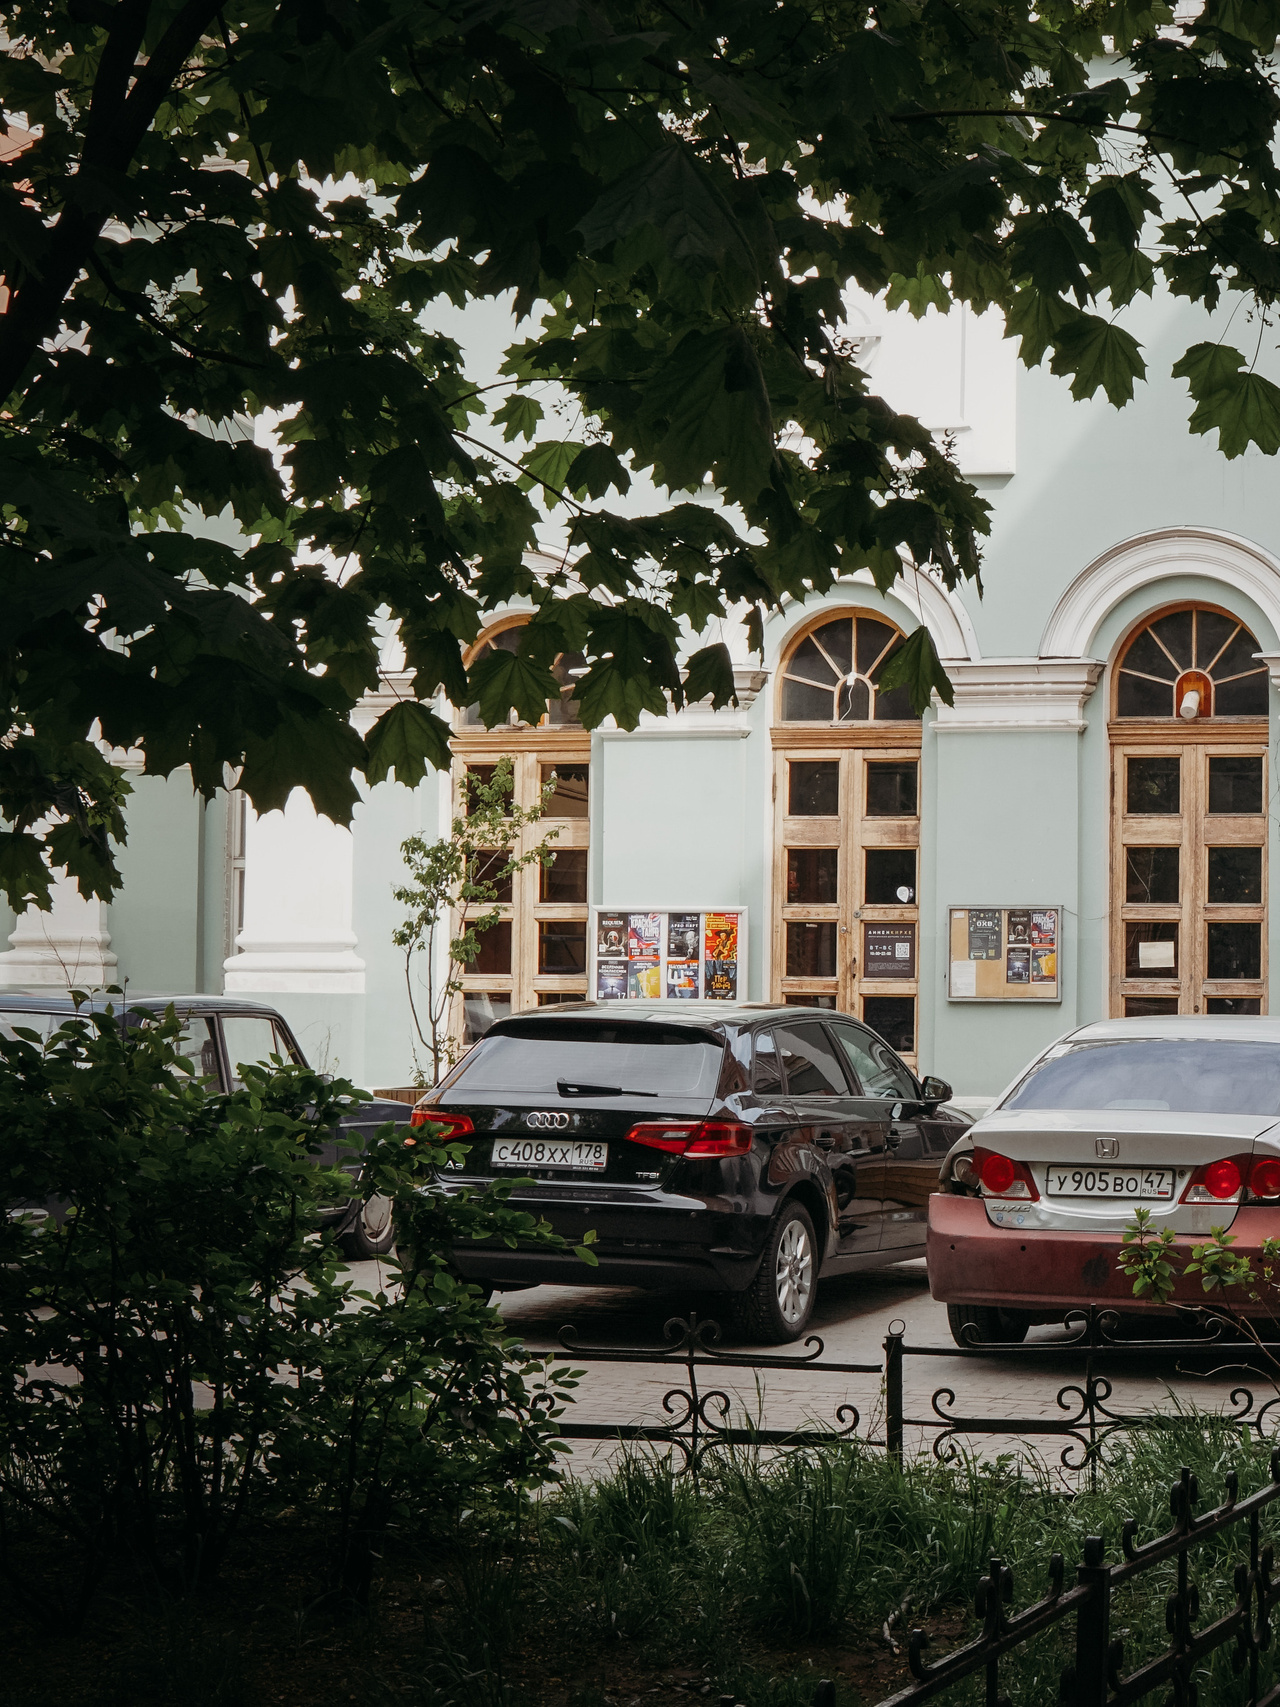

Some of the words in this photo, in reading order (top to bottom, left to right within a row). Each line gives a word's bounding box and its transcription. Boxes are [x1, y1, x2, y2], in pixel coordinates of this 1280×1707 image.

[574, 1143, 603, 1159] 178
[580, 1158, 594, 1166] RUS
[1144, 1172, 1166, 1189] 47
